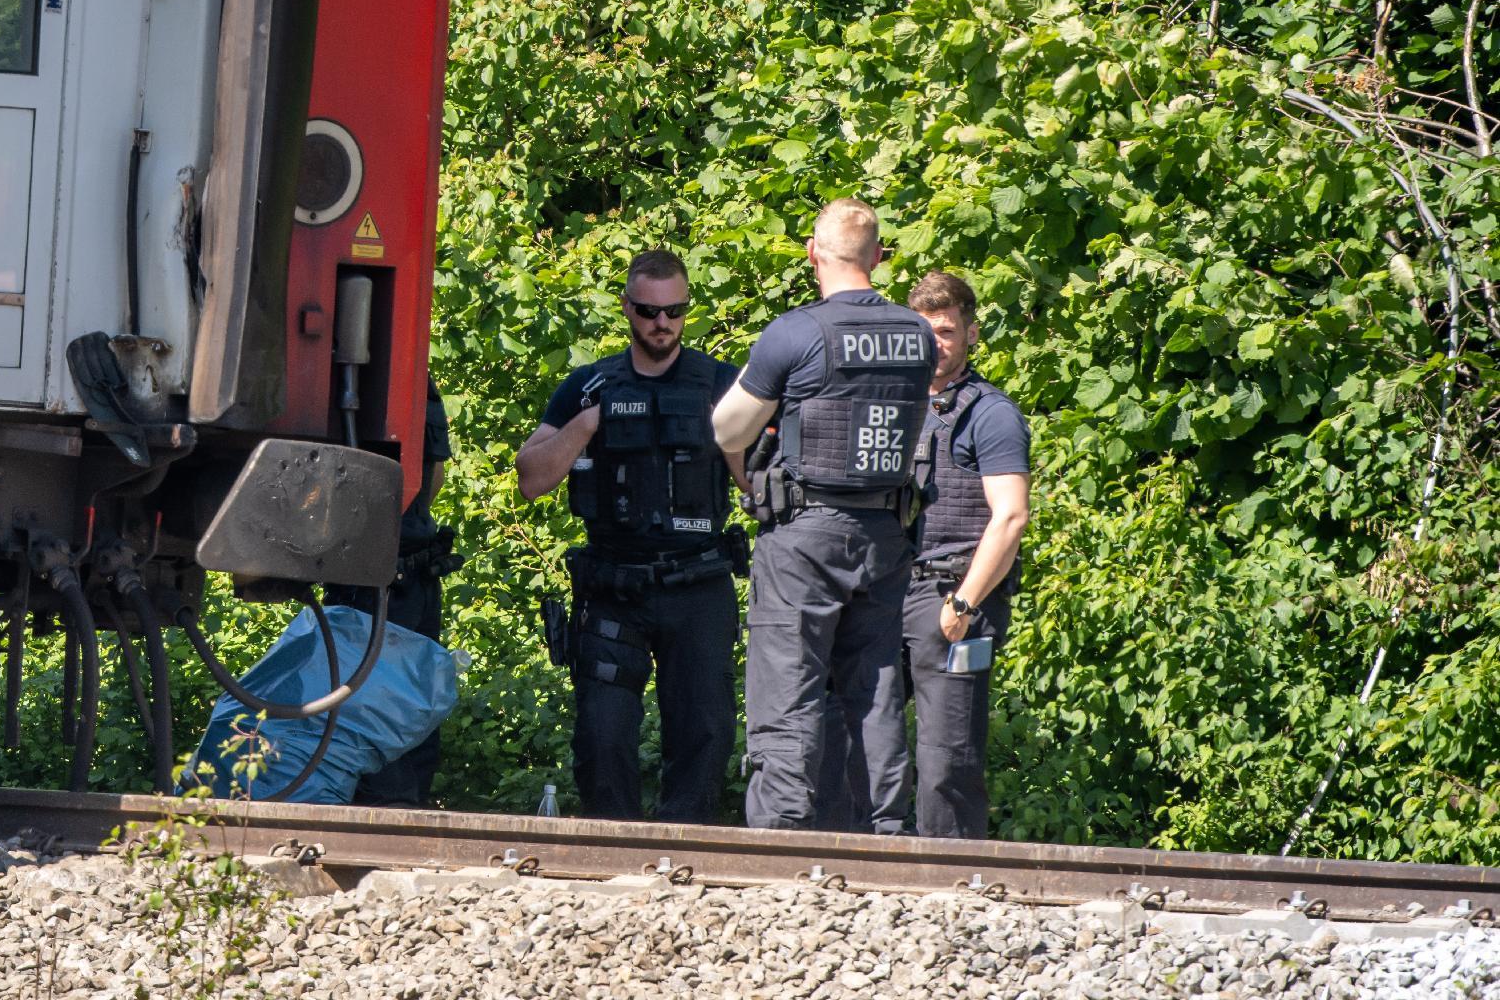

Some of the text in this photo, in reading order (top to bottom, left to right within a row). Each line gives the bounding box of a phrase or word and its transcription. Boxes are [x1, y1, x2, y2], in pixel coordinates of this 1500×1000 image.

[843, 333, 924, 362] POLIZEI
[611, 402, 647, 414] POLIZEI
[868, 405, 898, 426] BP
[858, 428, 903, 449] BBZ
[855, 450, 901, 472] 3160
[675, 519, 710, 530] POLIZEI
